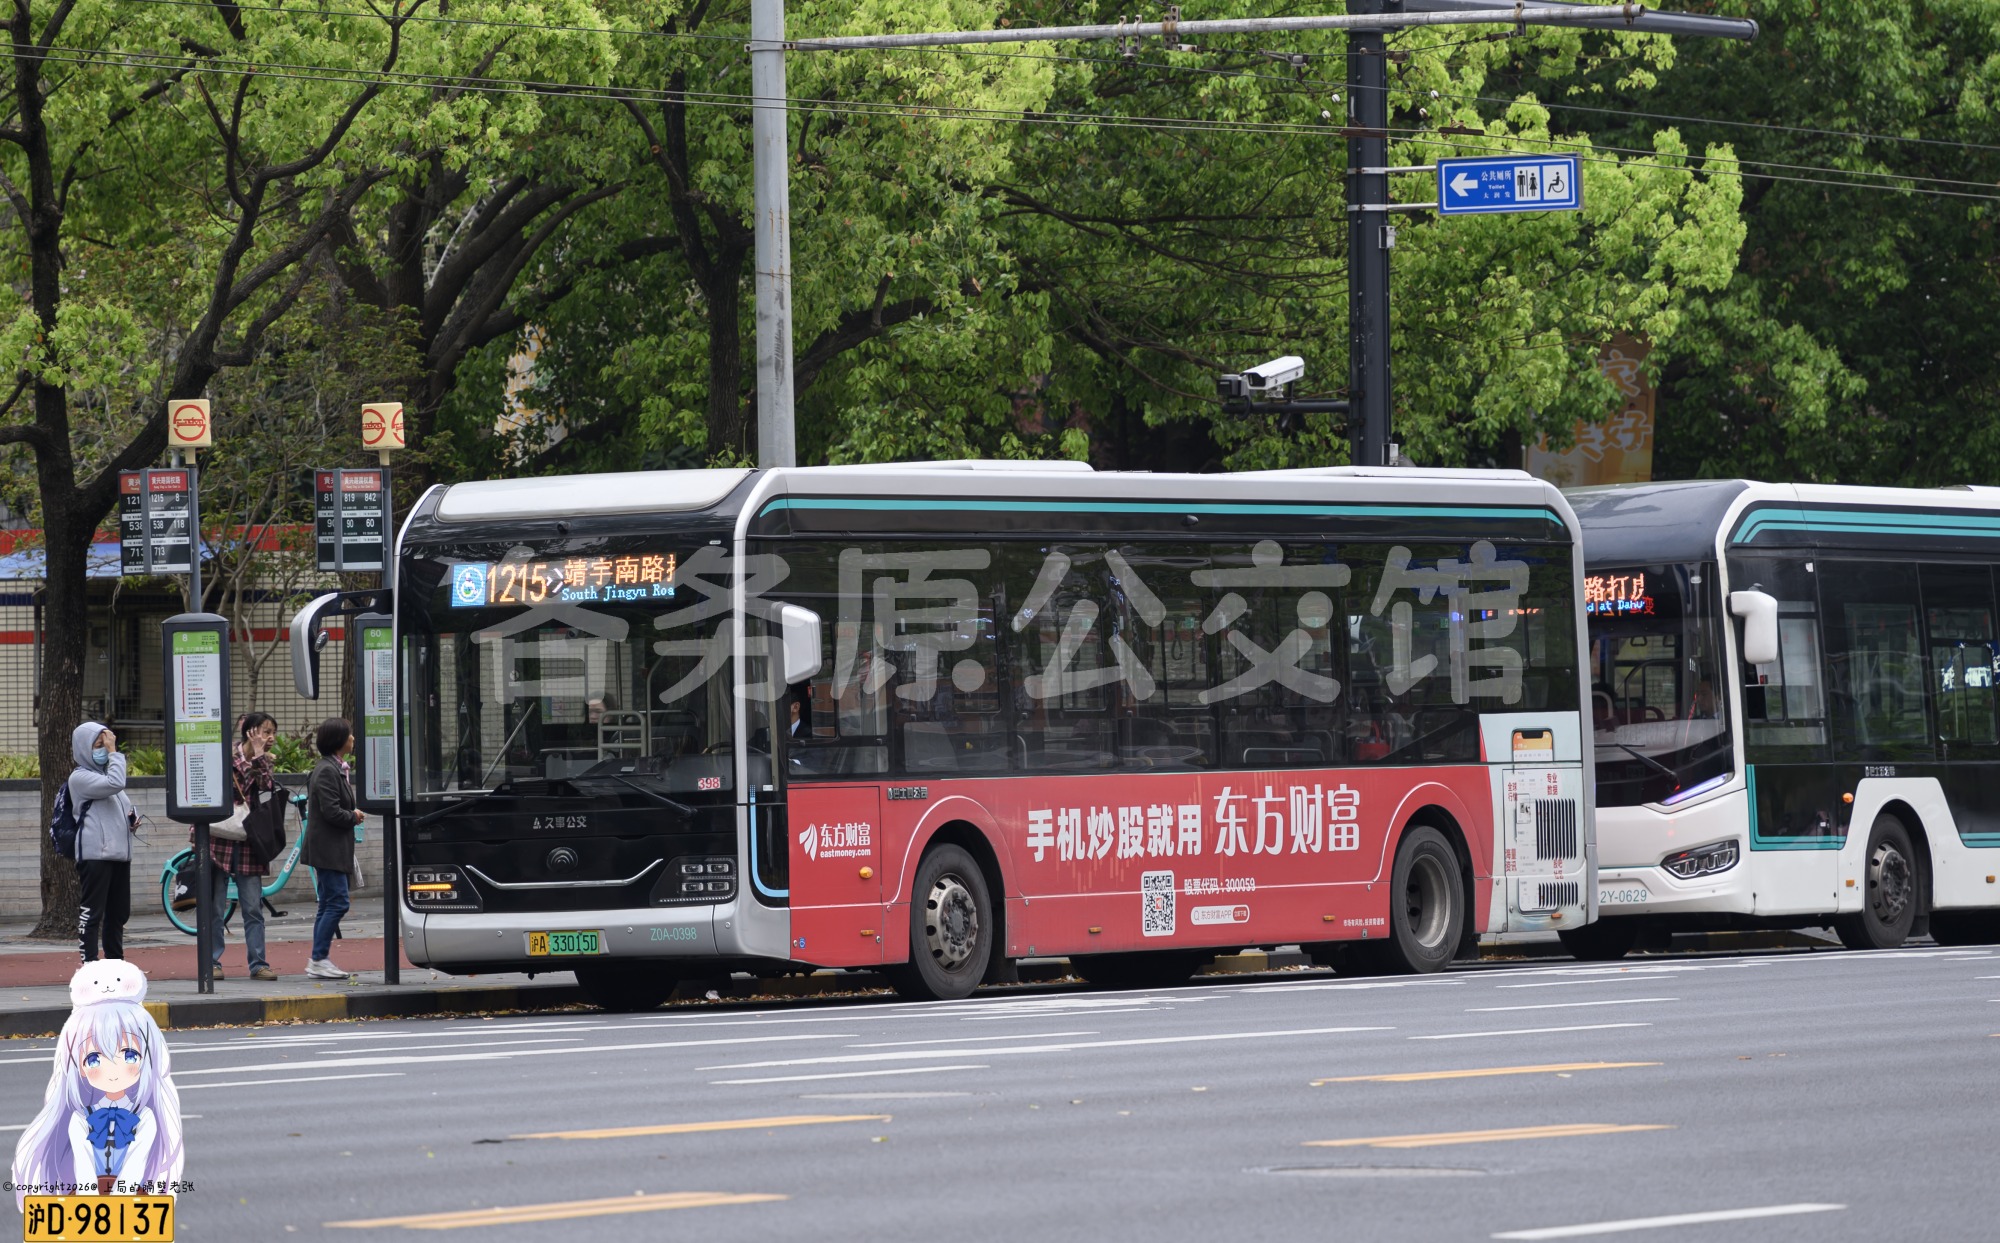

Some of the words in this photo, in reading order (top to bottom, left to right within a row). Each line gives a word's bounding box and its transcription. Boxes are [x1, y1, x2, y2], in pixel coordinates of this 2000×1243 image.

[1481, 170, 1512, 182] 公共厕所
[151, 493, 164, 503] 1215
[175, 492, 180, 502] 8
[344, 493, 355, 502] 819
[364, 492, 377, 502] 842
[153, 520, 164, 530] 538
[173, 519, 185, 529] 118
[346, 519, 354, 528] 90
[365, 518, 375, 528] 60
[154, 546, 166, 556] 713
[487, 563, 547, 603] 1215
[562, 585, 598, 601] South
[603, 584, 647, 602] Jingyu
[653, 583, 675, 596] Roa
[1600, 600, 1613, 611] at
[182, 633, 188, 642] 8
[370, 629, 381, 638] 60
[369, 716, 385, 725] 819
[180, 722, 196, 732] 118
[698, 777, 720, 790] 398
[545, 815, 587, 829] 久事公交
[1213, 783, 1361, 857] 东方财富
[820, 822, 871, 847] 东方财富
[1026, 804, 1202, 863] 手机炒股就用
[820, 848, 871, 858] eastmoney.com
[1600, 889, 1647, 904] 2Y-0629
[79, 905, 91, 935] NIKE
